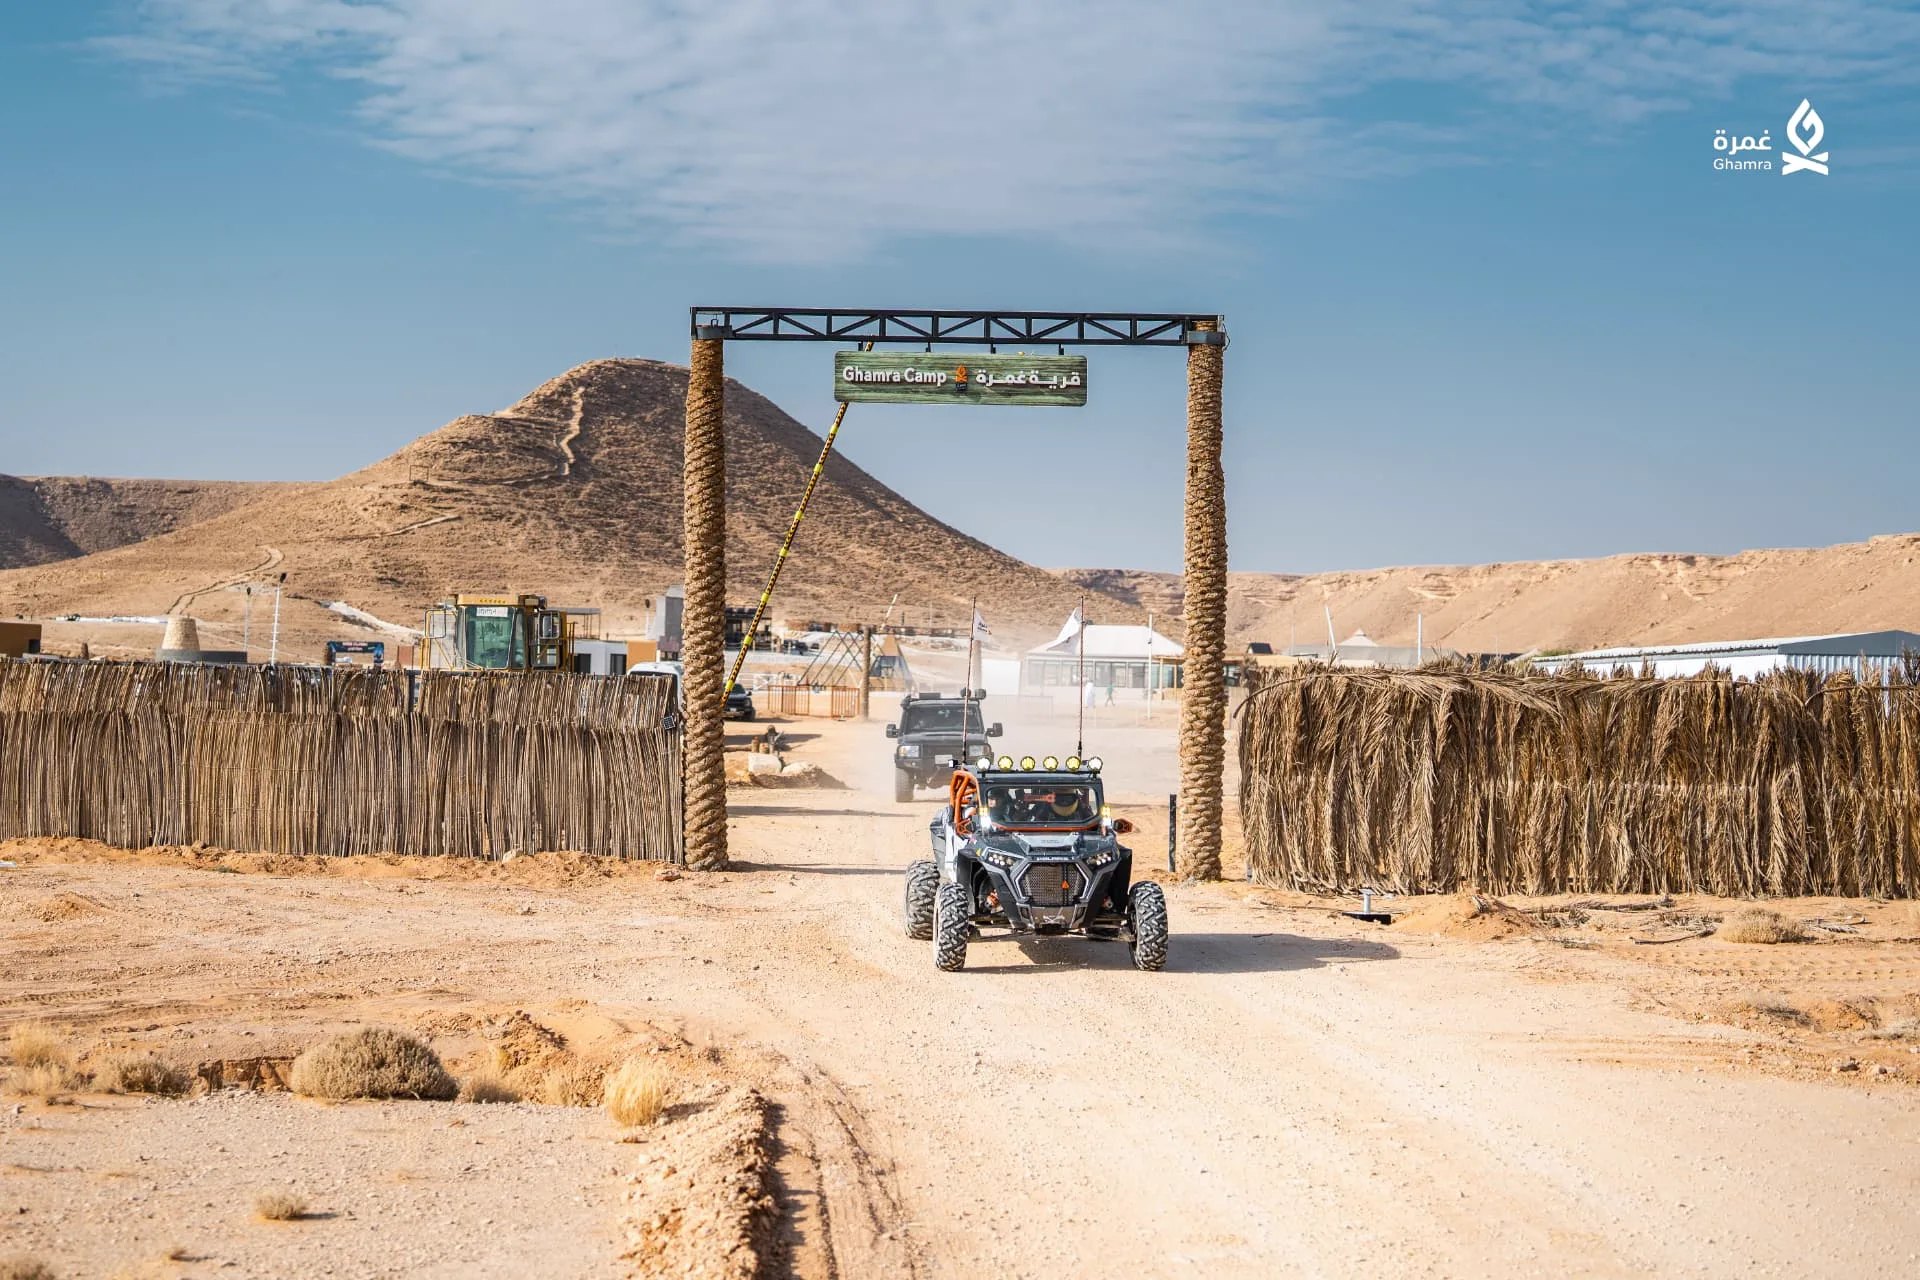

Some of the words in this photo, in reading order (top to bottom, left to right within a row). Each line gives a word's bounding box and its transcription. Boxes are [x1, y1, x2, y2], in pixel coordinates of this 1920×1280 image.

[842, 365, 900, 382] Ghamra
[903, 367, 947, 387] Camp
[975, 369, 1027, 387] غمرة
[1028, 369, 1080, 389] قرية
